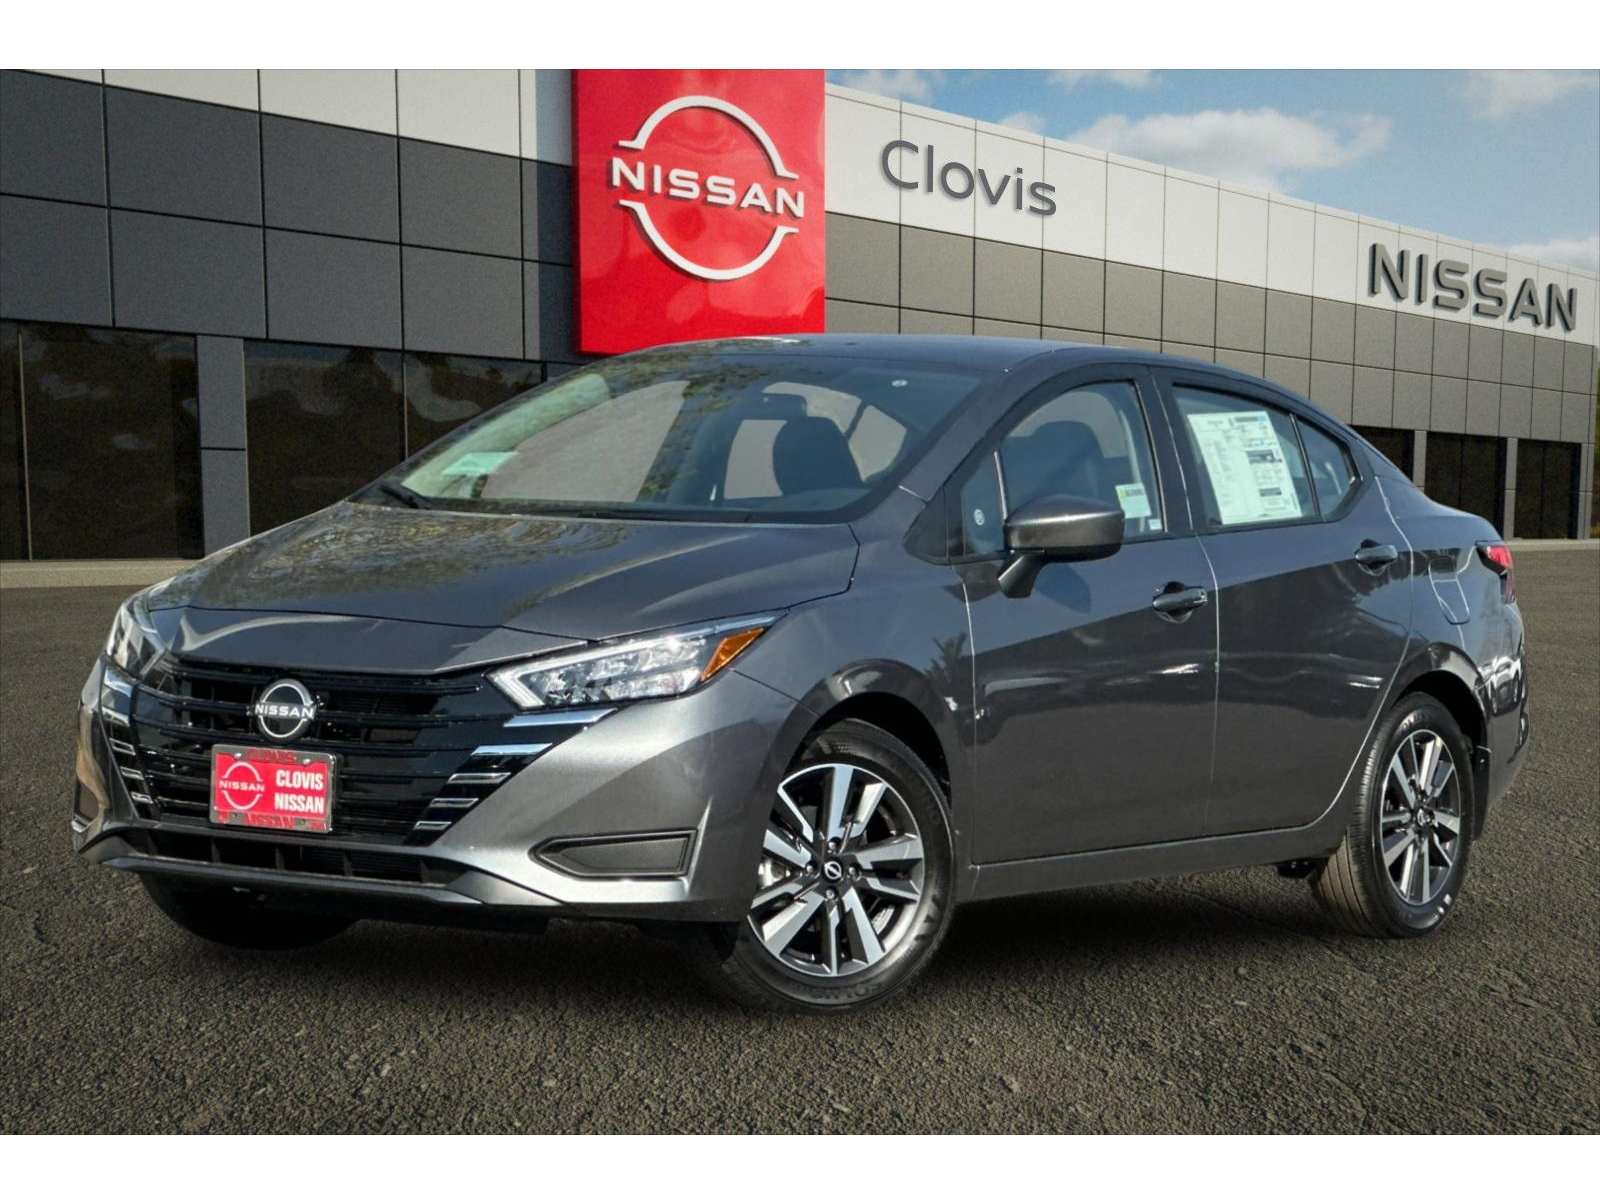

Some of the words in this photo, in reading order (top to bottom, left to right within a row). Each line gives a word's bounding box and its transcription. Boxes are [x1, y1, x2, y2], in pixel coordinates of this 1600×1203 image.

[611, 156, 805, 218] NISSAN
[882, 140, 1057, 216] Clovis
[1369, 243, 1577, 331] NISSAN
[255, 703, 315, 719] NISSAN
[219, 780, 265, 792] NISSAN
[276, 769, 324, 790] CLOVIS
[274, 792, 324, 814] NISSAN
